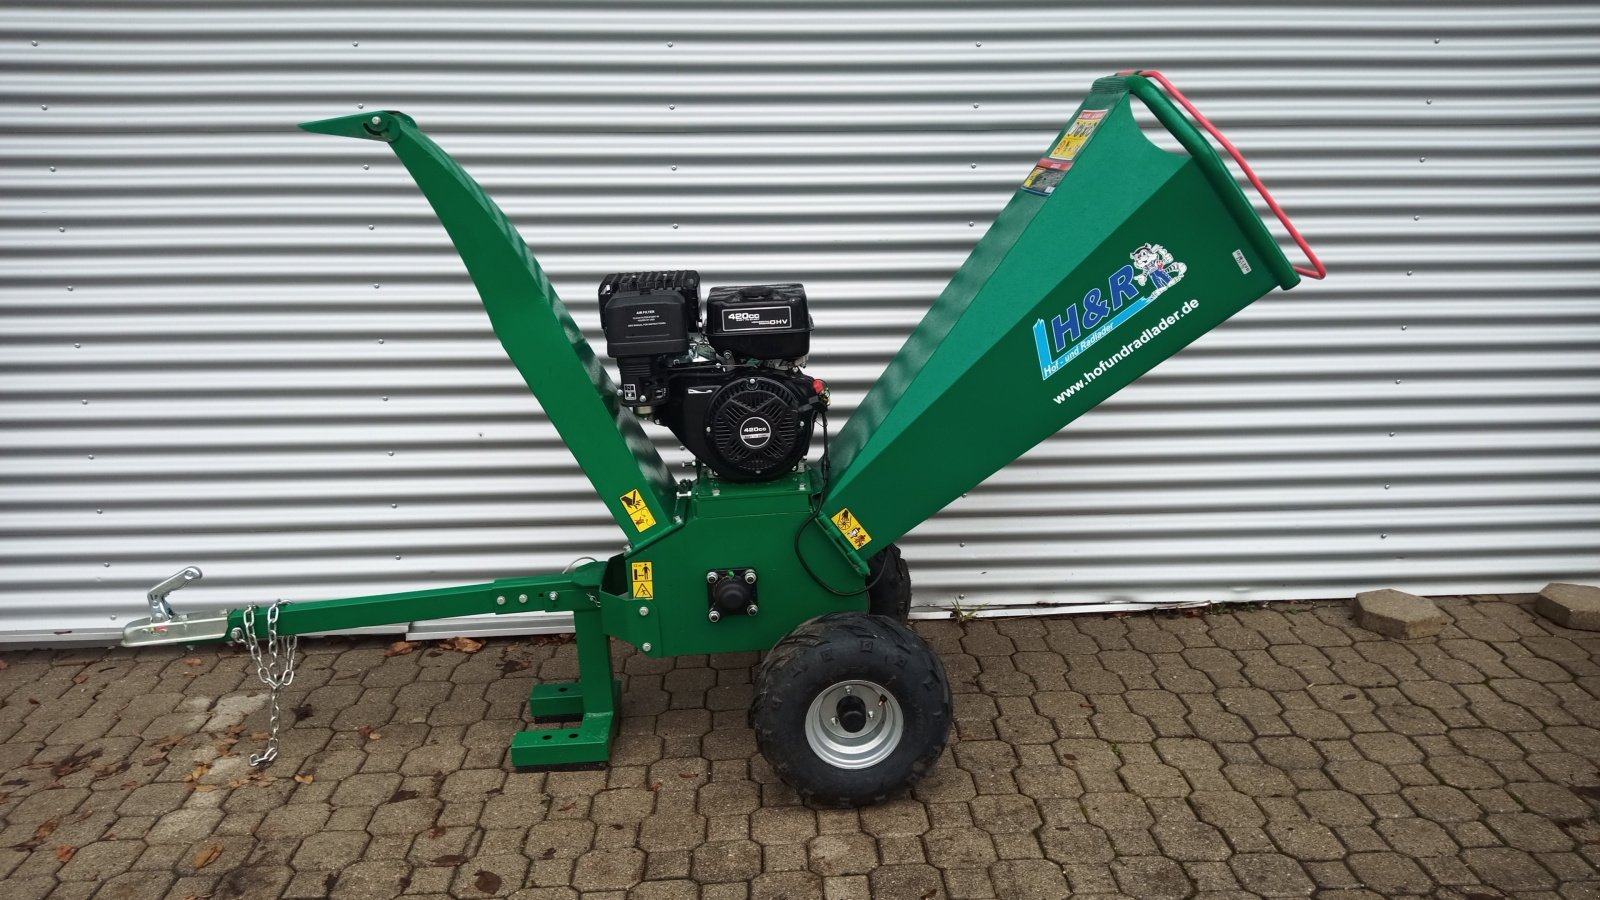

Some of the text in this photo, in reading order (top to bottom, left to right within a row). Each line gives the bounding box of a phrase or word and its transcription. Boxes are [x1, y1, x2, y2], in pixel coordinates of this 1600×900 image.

[728, 312, 760, 321] 420cc
[1051, 264, 1139, 353] H&R
[1043, 360, 1059, 378] Hof
[1064, 346, 1080, 362] und
[1080, 322, 1114, 351] Radlader
[1053, 299, 1199, 404] www.hofundradlader.de
